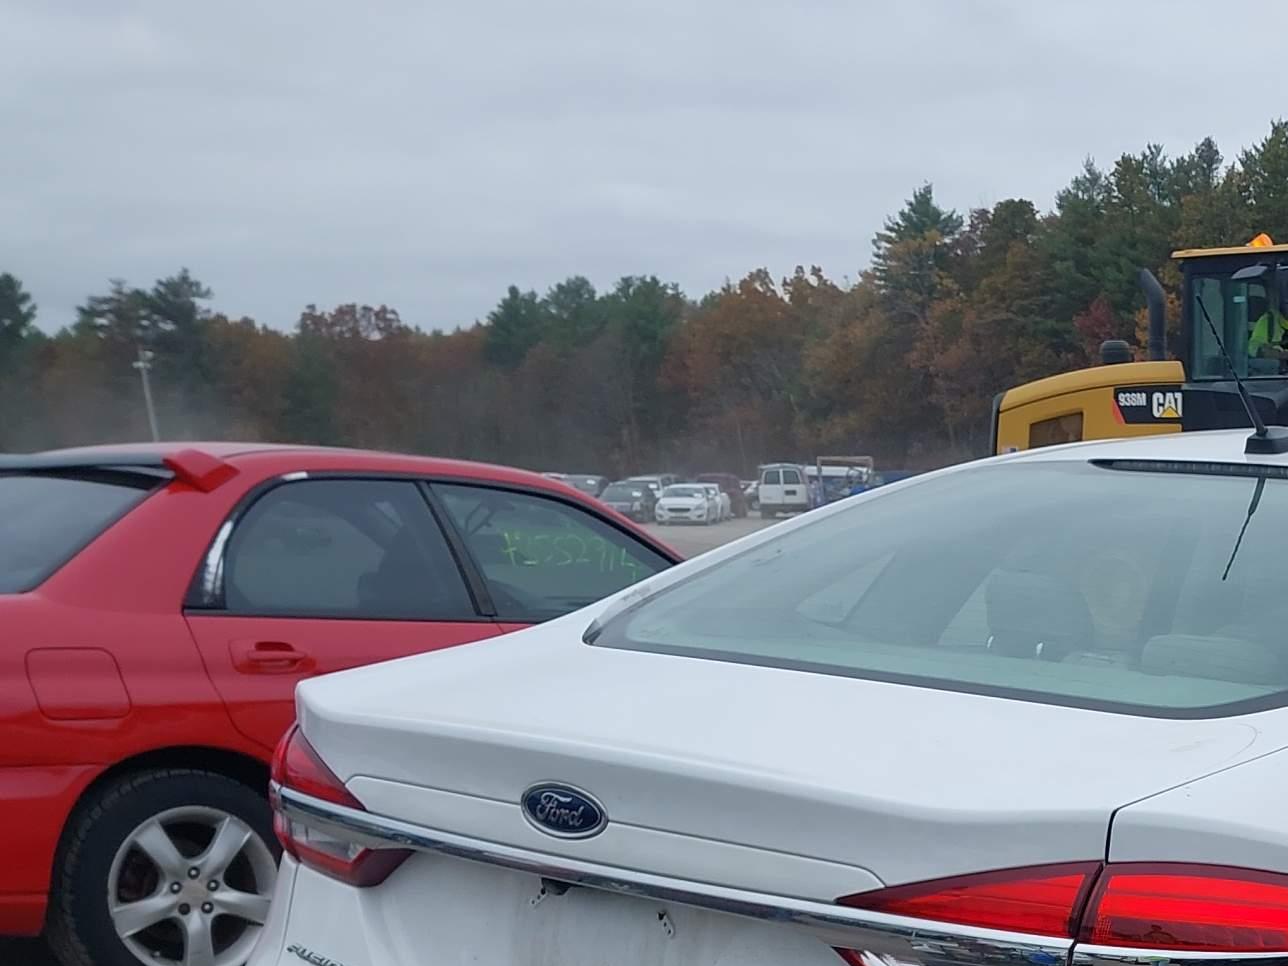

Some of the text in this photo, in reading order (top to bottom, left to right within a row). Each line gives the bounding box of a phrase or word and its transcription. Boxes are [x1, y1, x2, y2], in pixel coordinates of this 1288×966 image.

[1117, 392, 1183, 418] 938M CAT
[535, 791, 585, 827] Ford
